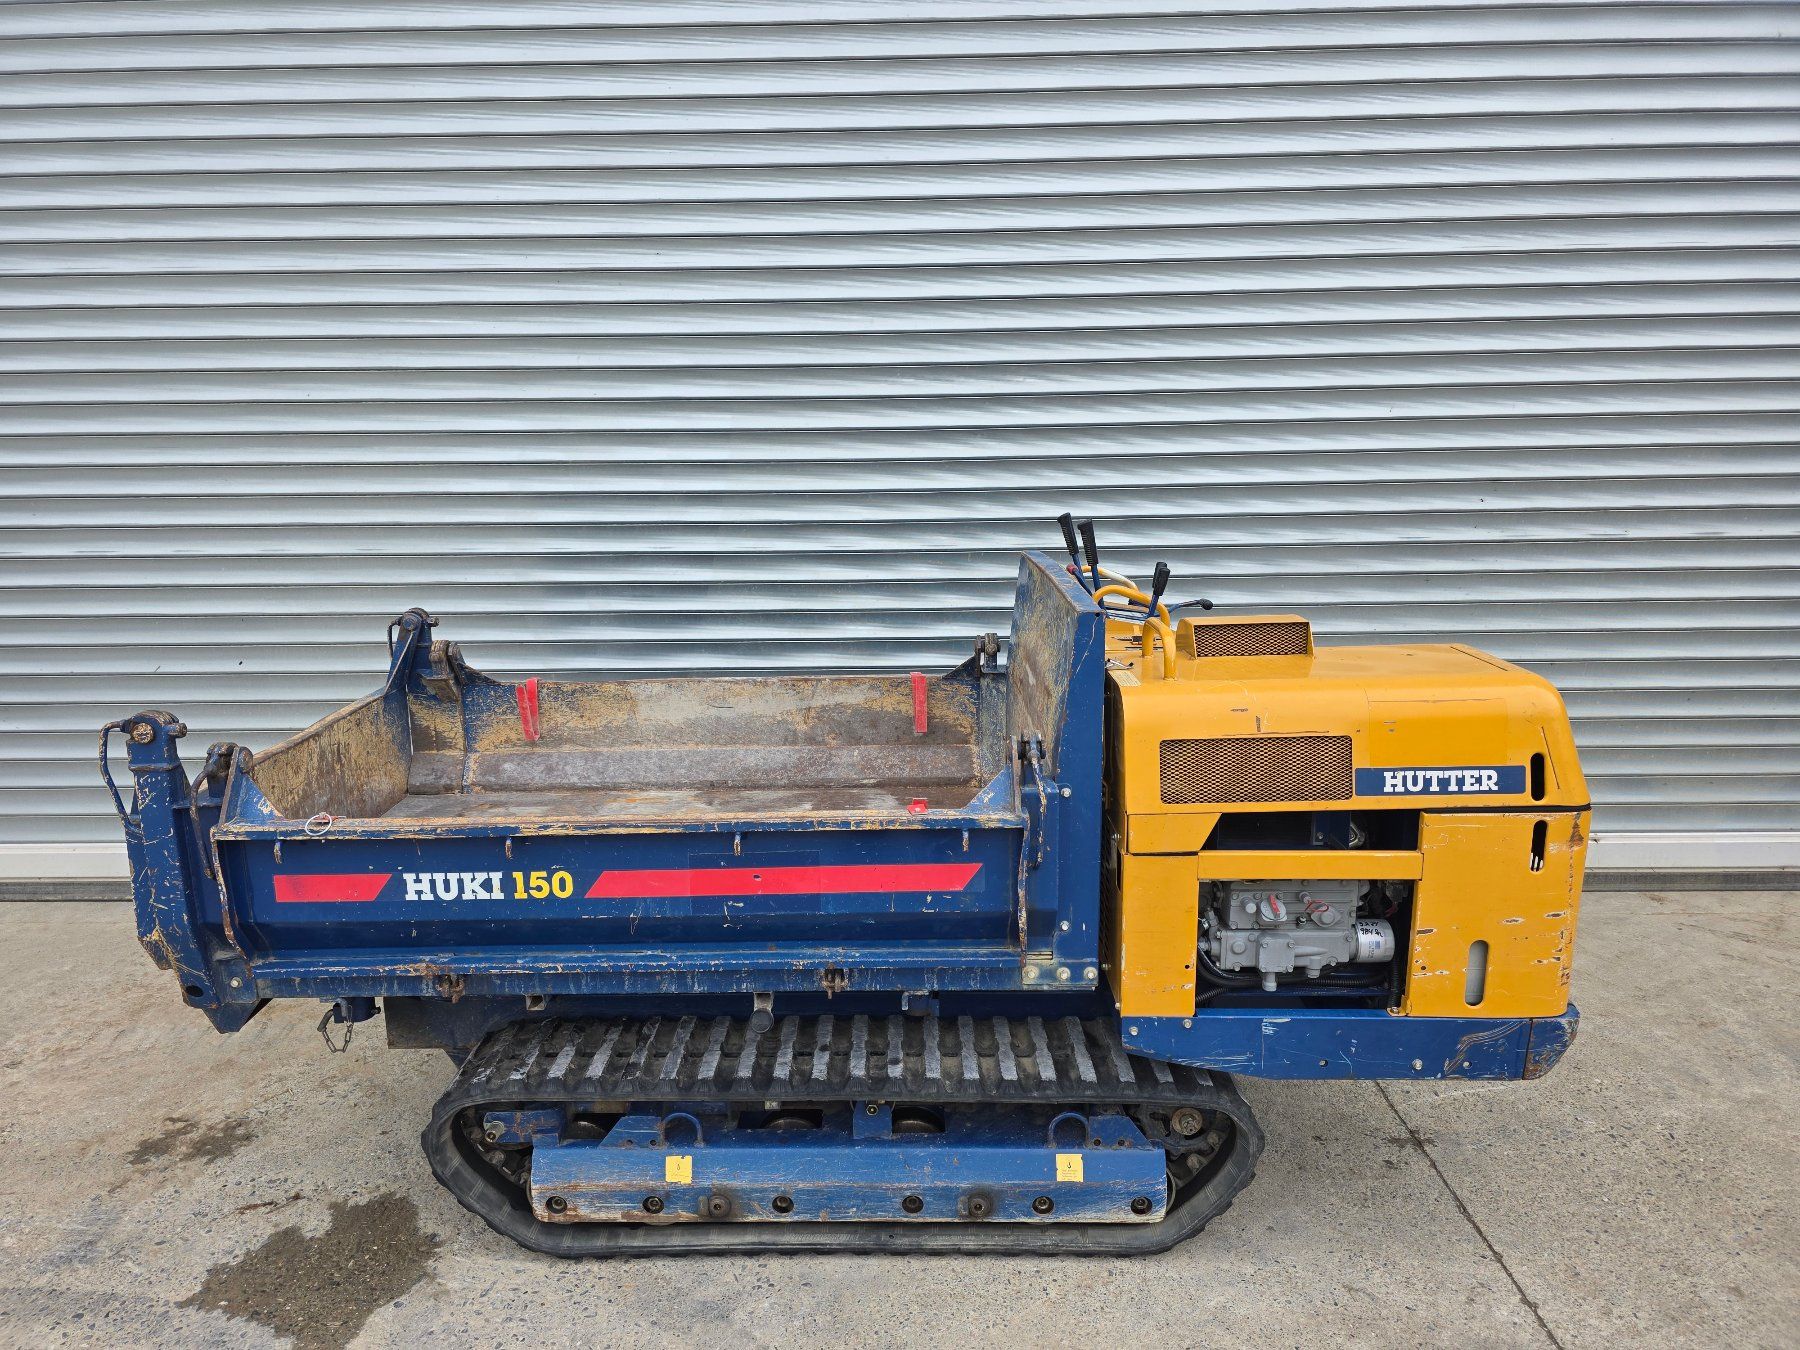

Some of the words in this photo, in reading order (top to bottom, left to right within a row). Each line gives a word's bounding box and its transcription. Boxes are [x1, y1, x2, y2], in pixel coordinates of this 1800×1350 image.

[1383, 769, 1499, 793] HUTTER
[402, 871, 505, 901] HUKI
[512, 870, 574, 900] 150
